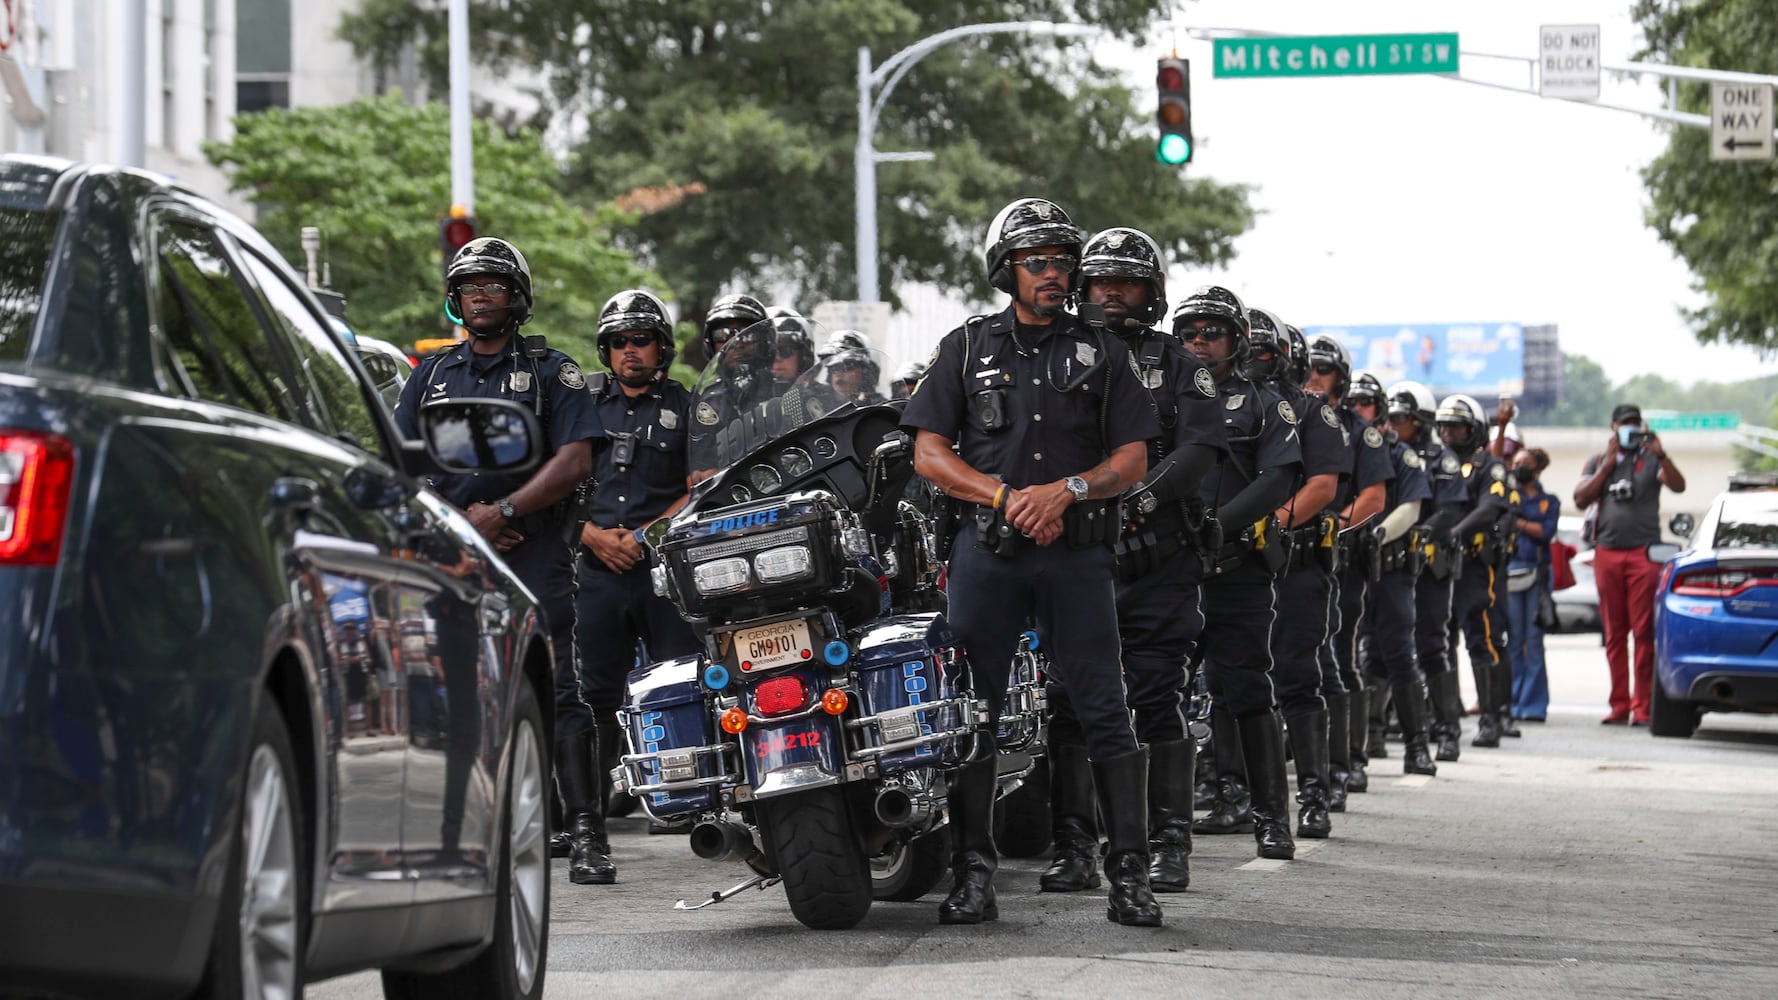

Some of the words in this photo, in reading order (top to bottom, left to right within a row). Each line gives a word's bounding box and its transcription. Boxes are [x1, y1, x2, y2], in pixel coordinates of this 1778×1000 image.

[1543, 32, 1563, 50] DO
[1570, 32, 1596, 50] NOT
[1222, 43, 1376, 71] Mitchell
[1389, 43, 1413, 65] ST
[1422, 43, 1450, 65] SW
[1546, 55, 1594, 72] BLOCK
[1723, 87, 1762, 108] ONE
[1721, 111, 1762, 130] WAY
[710, 508, 779, 535] POLICE
[747, 624, 796, 640] GEORGIA
[749, 633, 797, 659] GM9101
[756, 731, 822, 758] 34212
